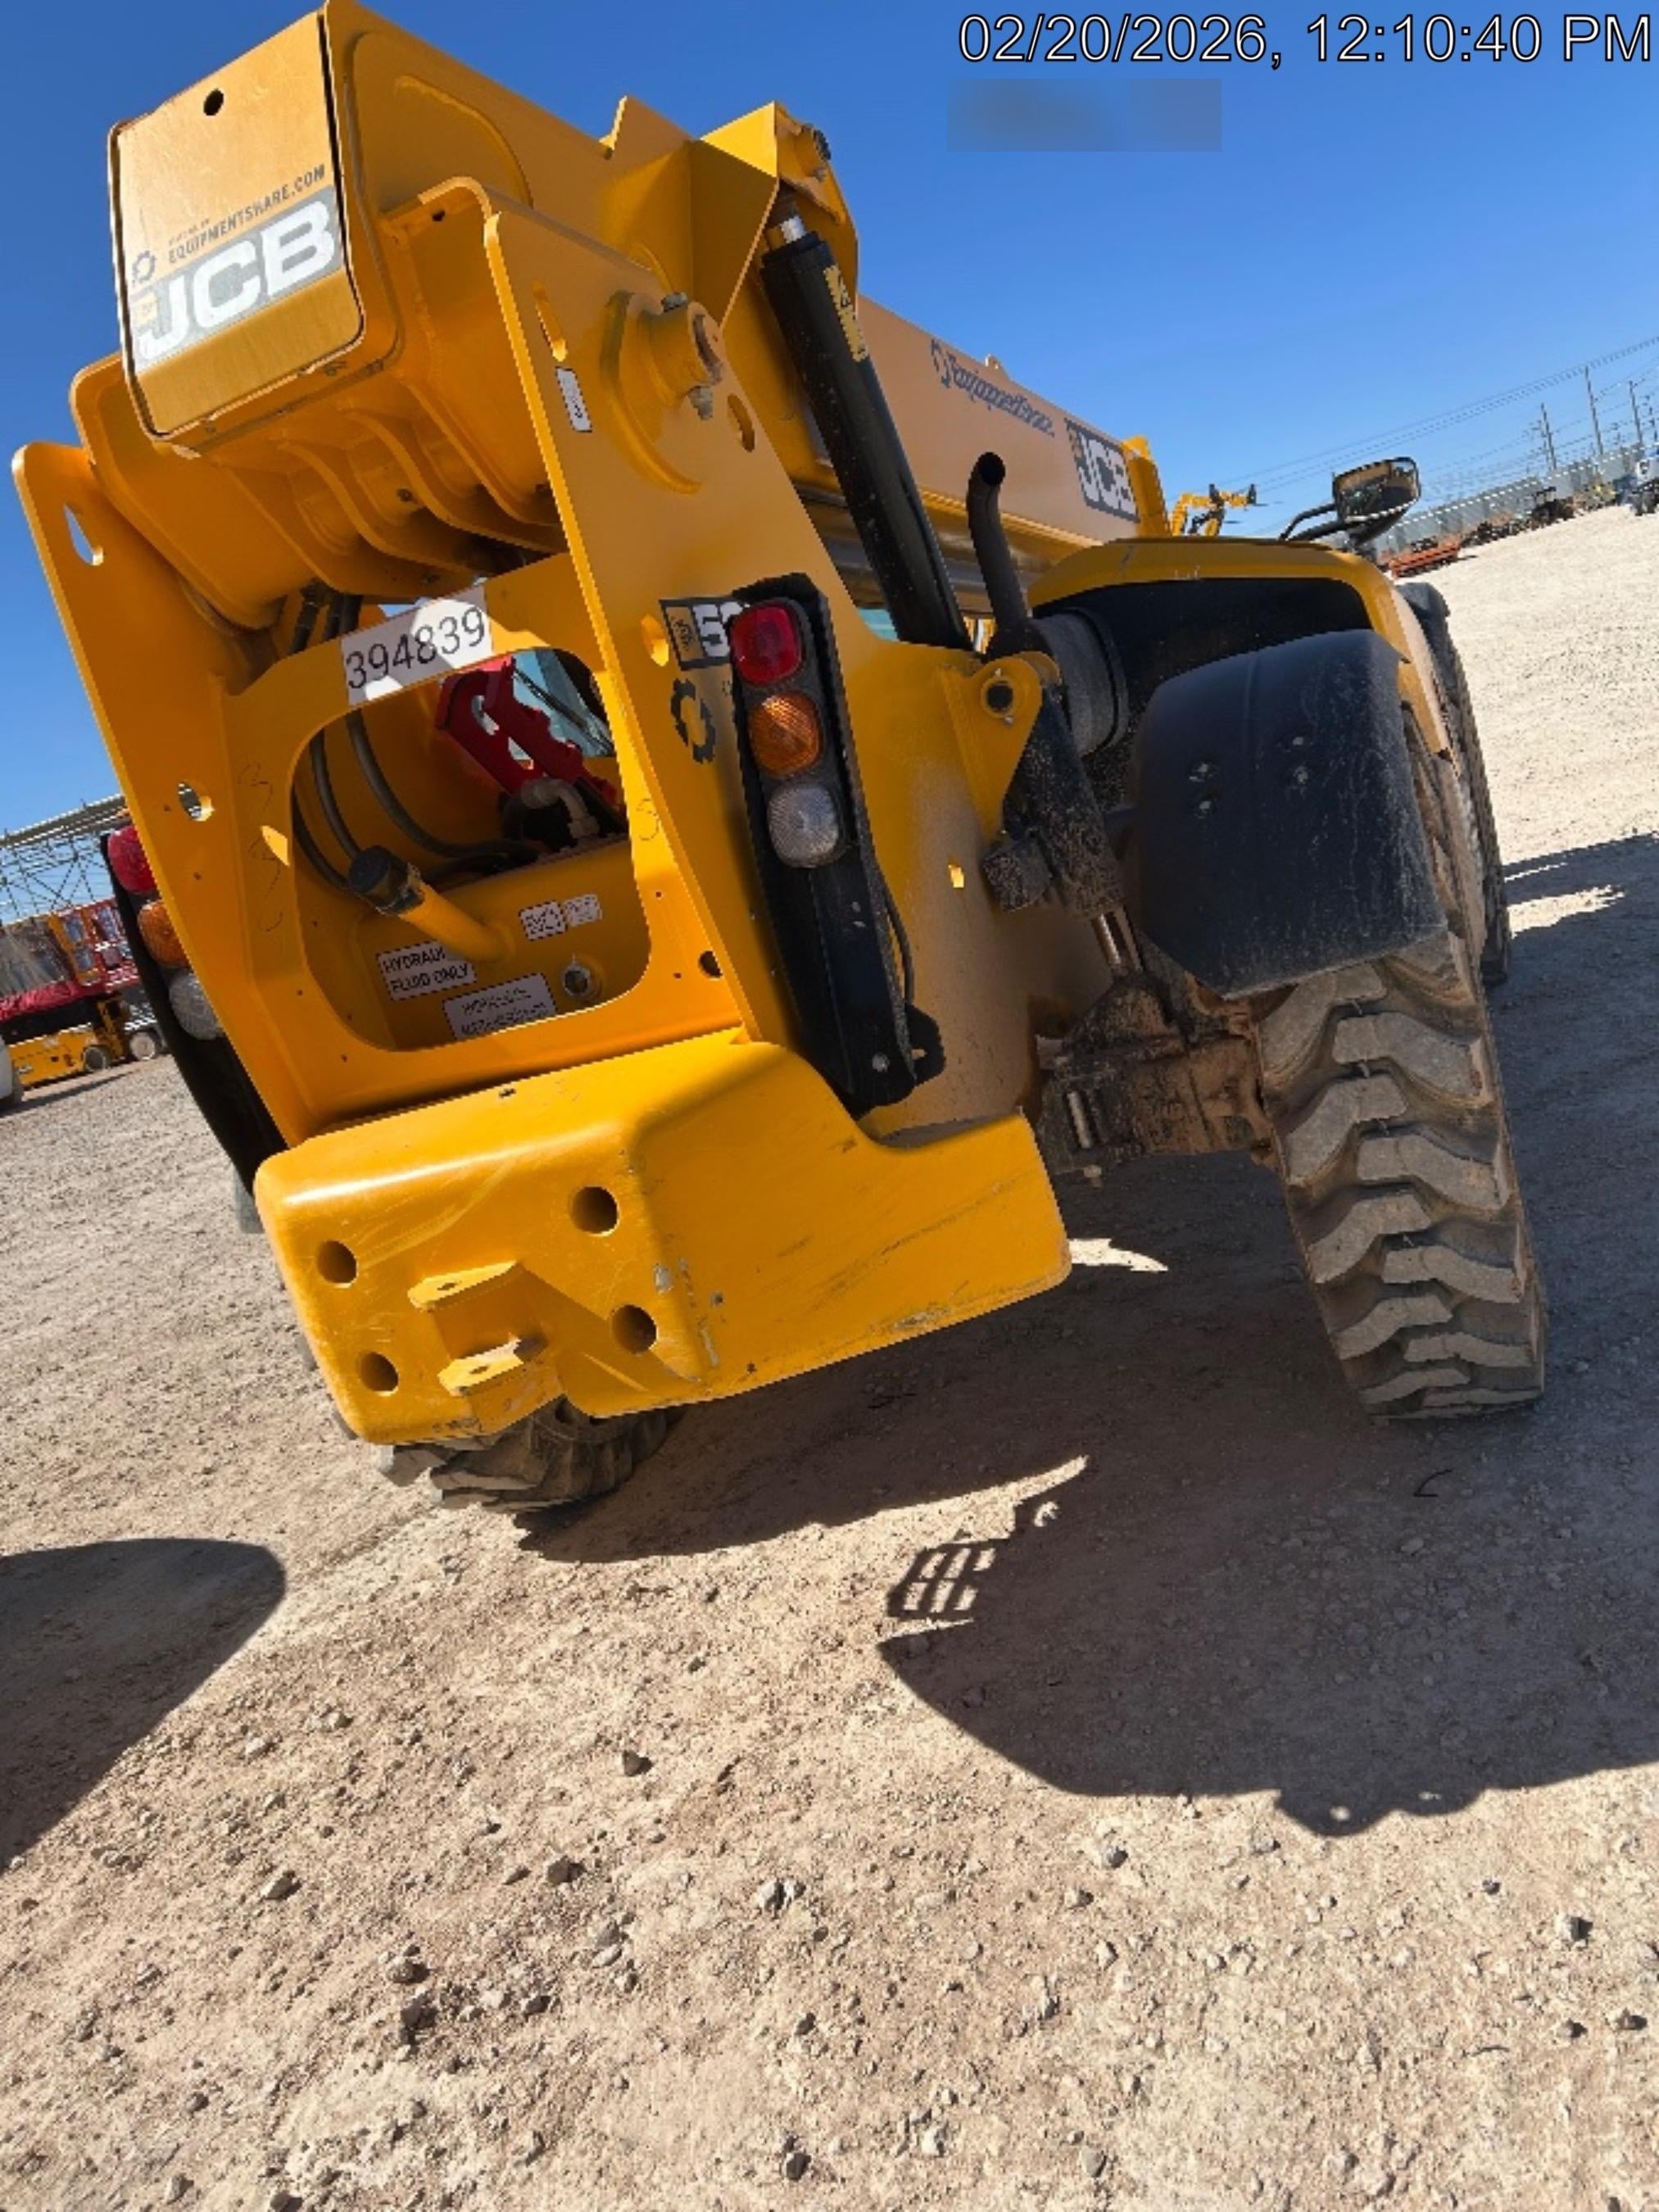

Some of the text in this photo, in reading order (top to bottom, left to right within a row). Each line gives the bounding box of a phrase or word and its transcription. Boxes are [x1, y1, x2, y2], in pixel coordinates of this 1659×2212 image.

[168, 164, 325, 264] EQUIPMENTSHARE.COM
[136, 201, 335, 360] JCB
[1077, 431, 1136, 516] JCB
[345, 606, 486, 689] 394839
[390, 963, 469, 993] FLUID ONLY
